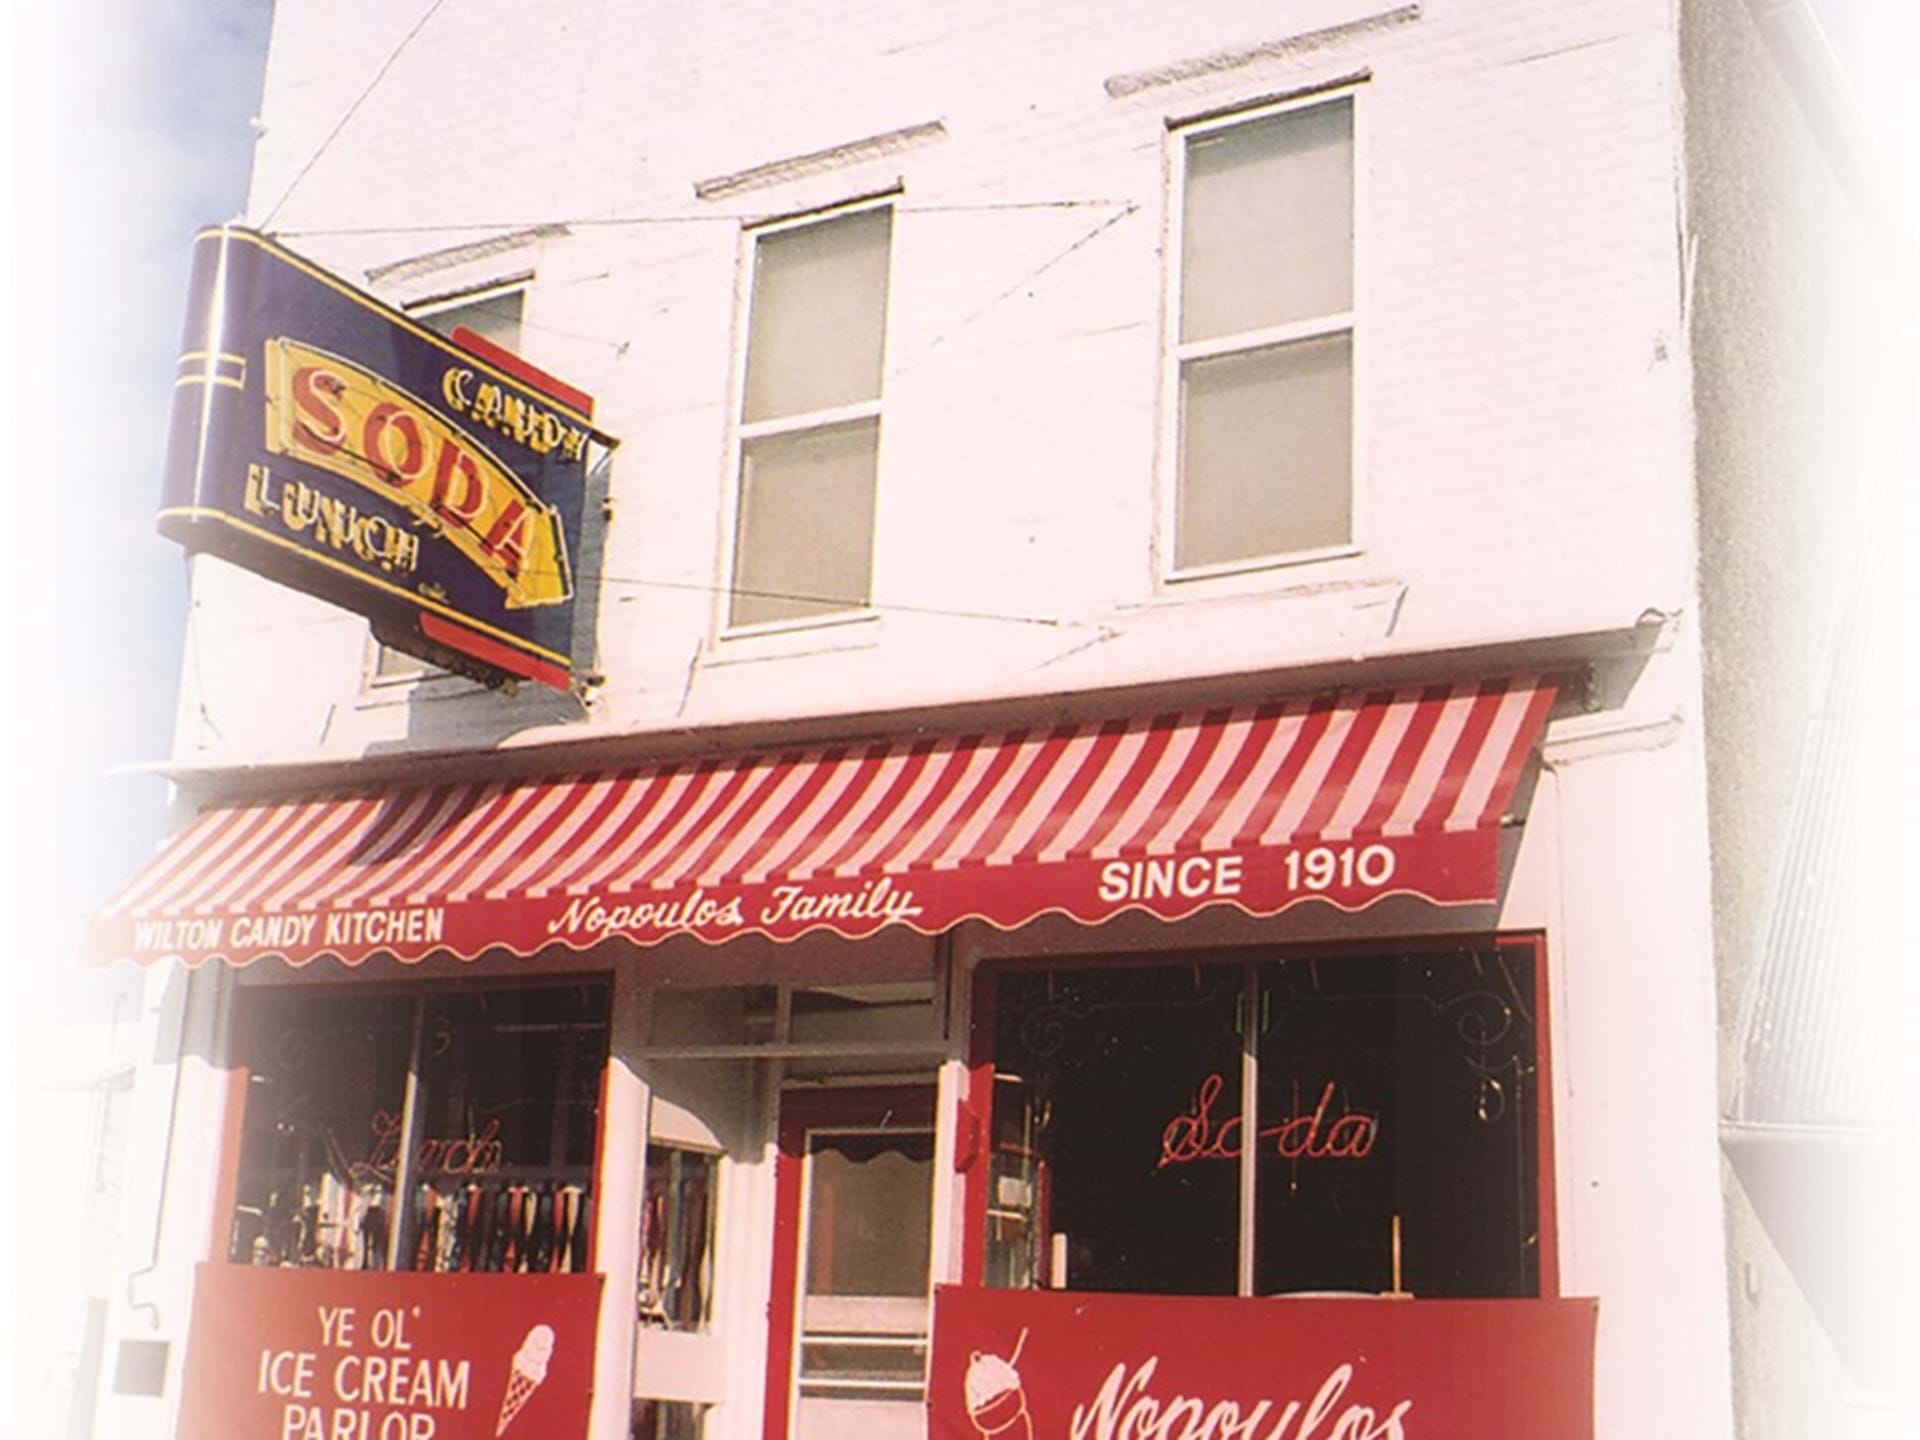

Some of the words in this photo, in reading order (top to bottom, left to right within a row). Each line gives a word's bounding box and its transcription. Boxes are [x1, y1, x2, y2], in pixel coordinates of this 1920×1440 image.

[441, 366, 589, 462] CANDY
[290, 365, 534, 584] SODA
[243, 463, 420, 573] LUNCH
[1099, 855, 1243, 902] SINCE
[1285, 844, 1396, 890] 1910
[134, 918, 222, 949] WILTON
[229, 914, 317, 947] CANDY
[325, 907, 445, 945] KITCHEN
[547, 888, 744, 938] Nopoulos
[760, 876, 923, 924] Family
[317, 1305, 356, 1348] YE
[257, 1348, 317, 1398] ICE
[334, 1354, 471, 1410] CREAM
